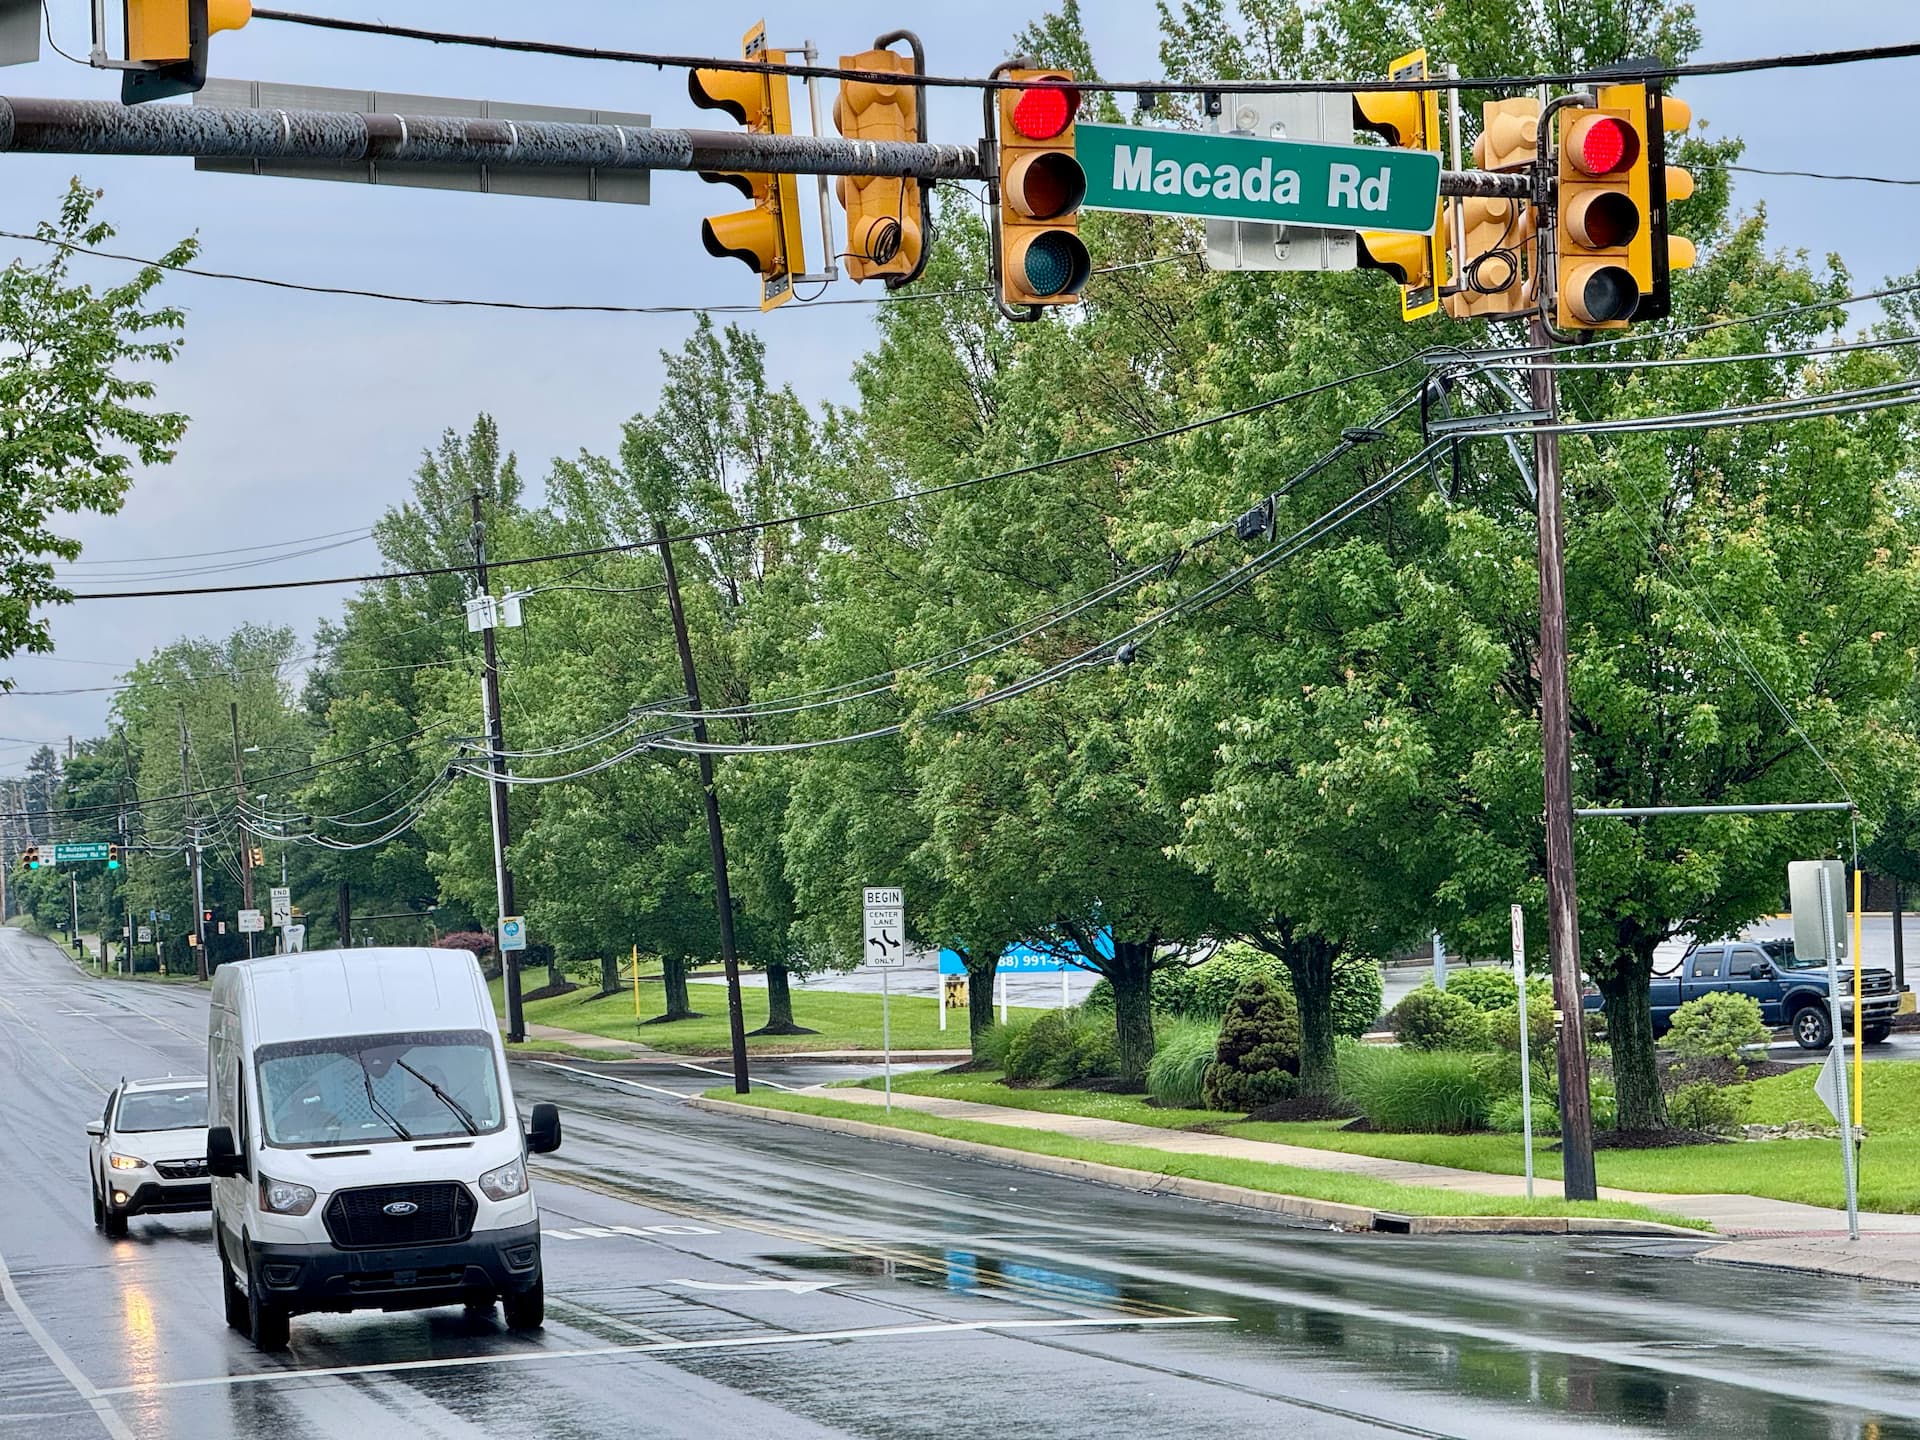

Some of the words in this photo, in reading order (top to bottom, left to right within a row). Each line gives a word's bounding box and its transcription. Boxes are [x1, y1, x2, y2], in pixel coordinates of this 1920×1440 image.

[1112, 144, 1300, 205] Macada
[1327, 162, 1391, 211] Rd
[867, 892, 899, 903] BEGIN
